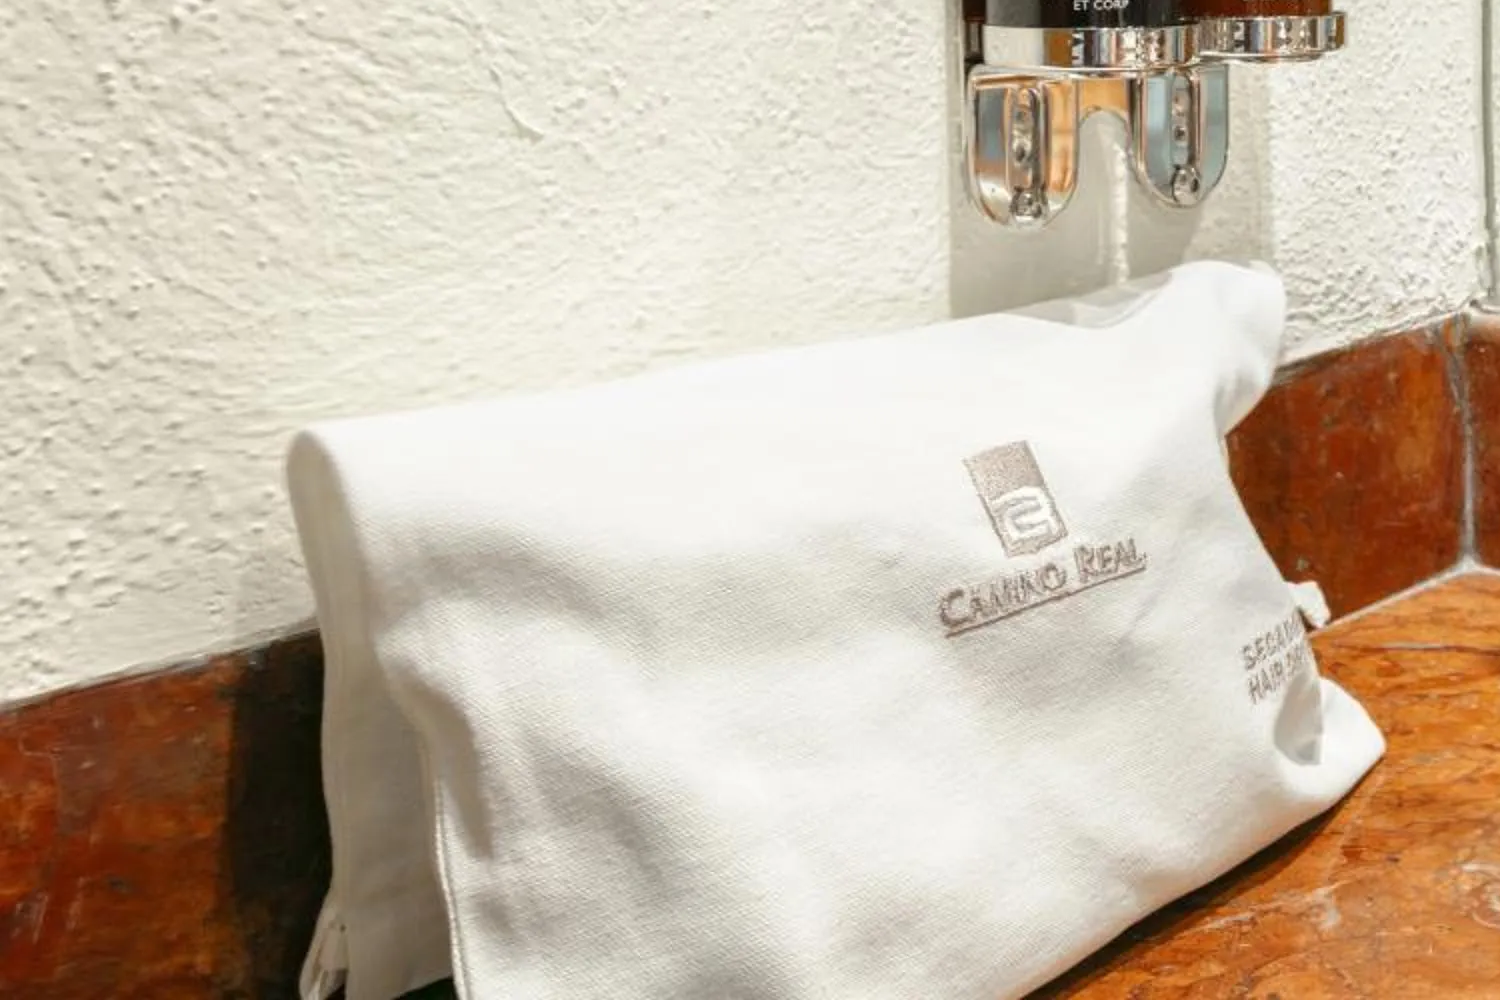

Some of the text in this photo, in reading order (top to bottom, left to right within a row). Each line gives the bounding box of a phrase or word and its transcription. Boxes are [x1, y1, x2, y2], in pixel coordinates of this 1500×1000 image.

[1073, 0, 1090, 11] ET
[938, 537, 1147, 628] CAMINO REAL
